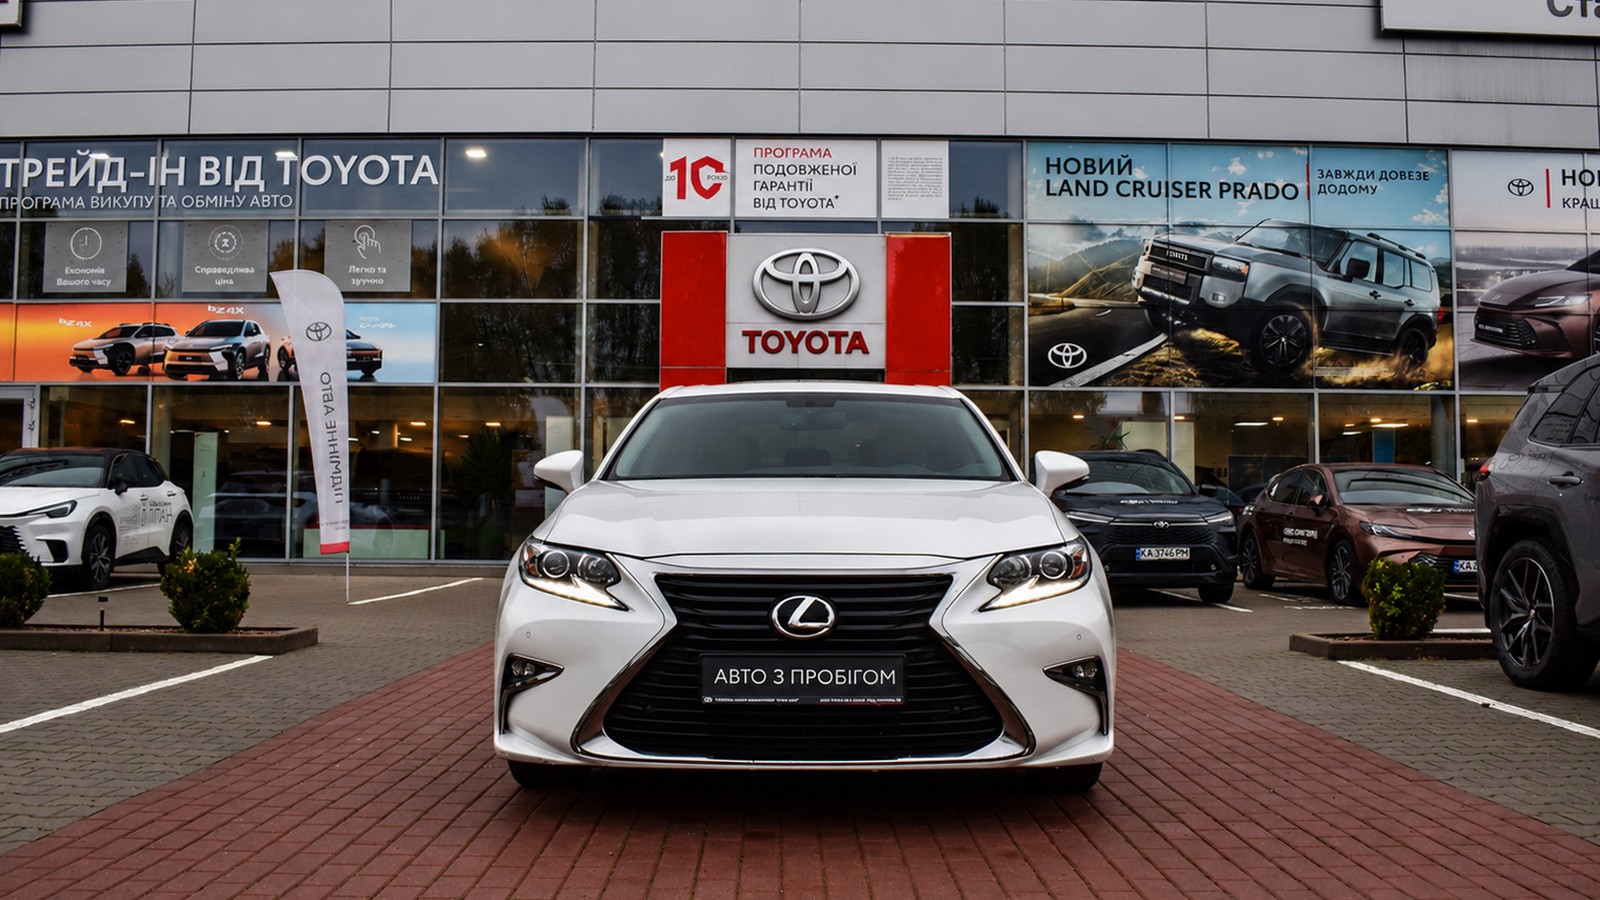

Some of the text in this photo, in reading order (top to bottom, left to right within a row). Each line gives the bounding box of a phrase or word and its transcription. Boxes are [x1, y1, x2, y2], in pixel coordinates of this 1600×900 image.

[753, 147, 832, 159] ПРОГРАМА
[753, 162, 858, 177] ПОДОВЖЕНОЇ
[1045, 154, 1133, 176] НОВИЙ
[199, 155, 265, 193] ВІД
[275, 154, 439, 186] TOYOTA
[1317, 168, 1430, 183] ЗАВЖДИ ДОВЕЗЕ
[1562, 168, 1600, 187] НО
[753, 178, 813, 192] ГАРАНТІЇ
[1045, 180, 1299, 201] LAND CRUISER PRADO
[1317, 183, 1378, 196] ДОДОМУ
[0, 194, 293, 210] ПРОГРАМА ВИКУПУ ТА ОБМІНУ АВТО
[753, 197, 776, 210] ВІД
[348, 264, 376, 274] Легко
[742, 330, 870, 355] TOYOTA
[713, 668, 896, 685] АВТО З ПРОБІГОМ
